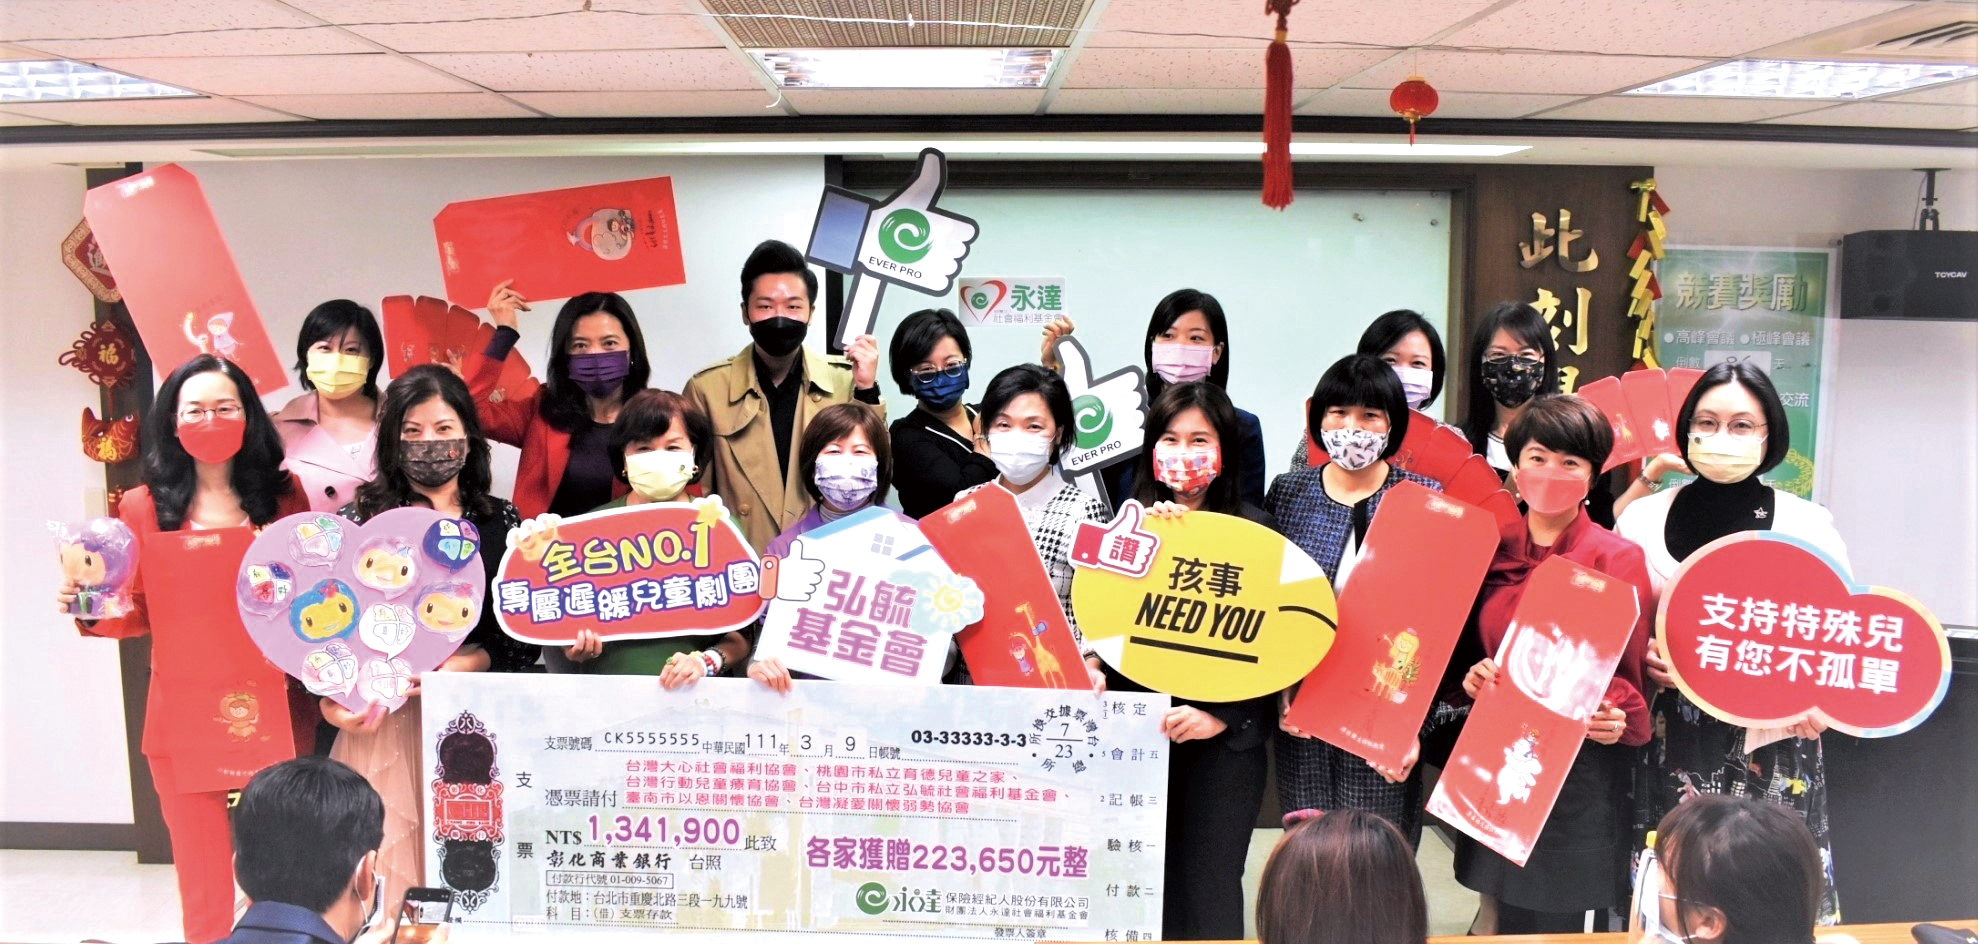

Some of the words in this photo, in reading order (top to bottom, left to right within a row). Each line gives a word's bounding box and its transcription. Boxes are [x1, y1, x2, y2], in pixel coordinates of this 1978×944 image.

[868, 255, 898, 273] EVER
[899, 264, 923, 281] PRO
[1010, 284, 1063, 312] 永達
[1517, 207, 1600, 397] 此刻
[993, 313, 1064, 325] 社會福利基金會
[1676, 329, 1736, 346] 高峰會議
[1751, 330, 1811, 347] 極峰會議
[1779, 392, 1810, 408] 交流
[1070, 448, 1099, 468] EVER
[1099, 440, 1123, 456] PRO
[541, 520, 712, 584] 全台NO.1
[1108, 534, 1141, 566] 讚
[1168, 555, 1245, 599] 孩事
[499, 561, 760, 623] 專屬遲緩兒童劇團
[825, 568, 923, 631] 弘毓
[1134, 592, 1208, 635] NEED
[1207, 602, 1267, 644] YOU
[1698, 592, 1905, 654] 支持特殊兒
[786, 607, 929, 679] 基金會
[1694, 633, 1901, 696] 有您不孤單
[1112, 701, 1148, 716] 核定
[1060, 723, 1070, 738] 7
[544, 736, 593, 752] 支票號碼
[604, 731, 700, 746] CK5555555
[702, 741, 746, 756] 中華民國
[745, 733, 777, 750] 111
[779, 743, 790, 756] 年
[799, 734, 812, 751] 3
[823, 744, 834, 758] 月
[844, 736, 857, 752] 9
[911, 729, 1028, 748] 03-33333-3-3
[1054, 744, 1074, 759] 23
[1111, 748, 1146, 762] 會計
[1149, 750, 1160, 760] 五
[515, 771, 533, 789] 支
[544, 789, 618, 809] 憑票請付
[1100, 795, 1105, 803] 2
[1109, 793, 1145, 807] 記帳
[1147, 796, 1158, 806] 三
[545, 829, 583, 846] NT$
[588, 814, 741, 848] 1,341,900
[744, 835, 777, 852] 此致
[516, 842, 534, 859] 票
[1107, 838, 1143, 853] 驗核
[546, 850, 673, 871] 彰化商業銀行
[689, 853, 722, 872] 台照
[805, 835, 1090, 879] 各家獲贈223,650元整
[551, 872, 608, 886] 付款行代號
[609, 874, 669, 887] 01-009-5067
[945, 891, 1090, 910] 保險經紀人股份有限公司
[1105, 883, 1142, 898] 付款
[1144, 887, 1155, 896] 二
[945, 905, 1090, 921] 財團法人永達社會福利基金會
[994, 927, 1048, 940] 發票人簽章
[1104, 928, 1140, 943] 核備
